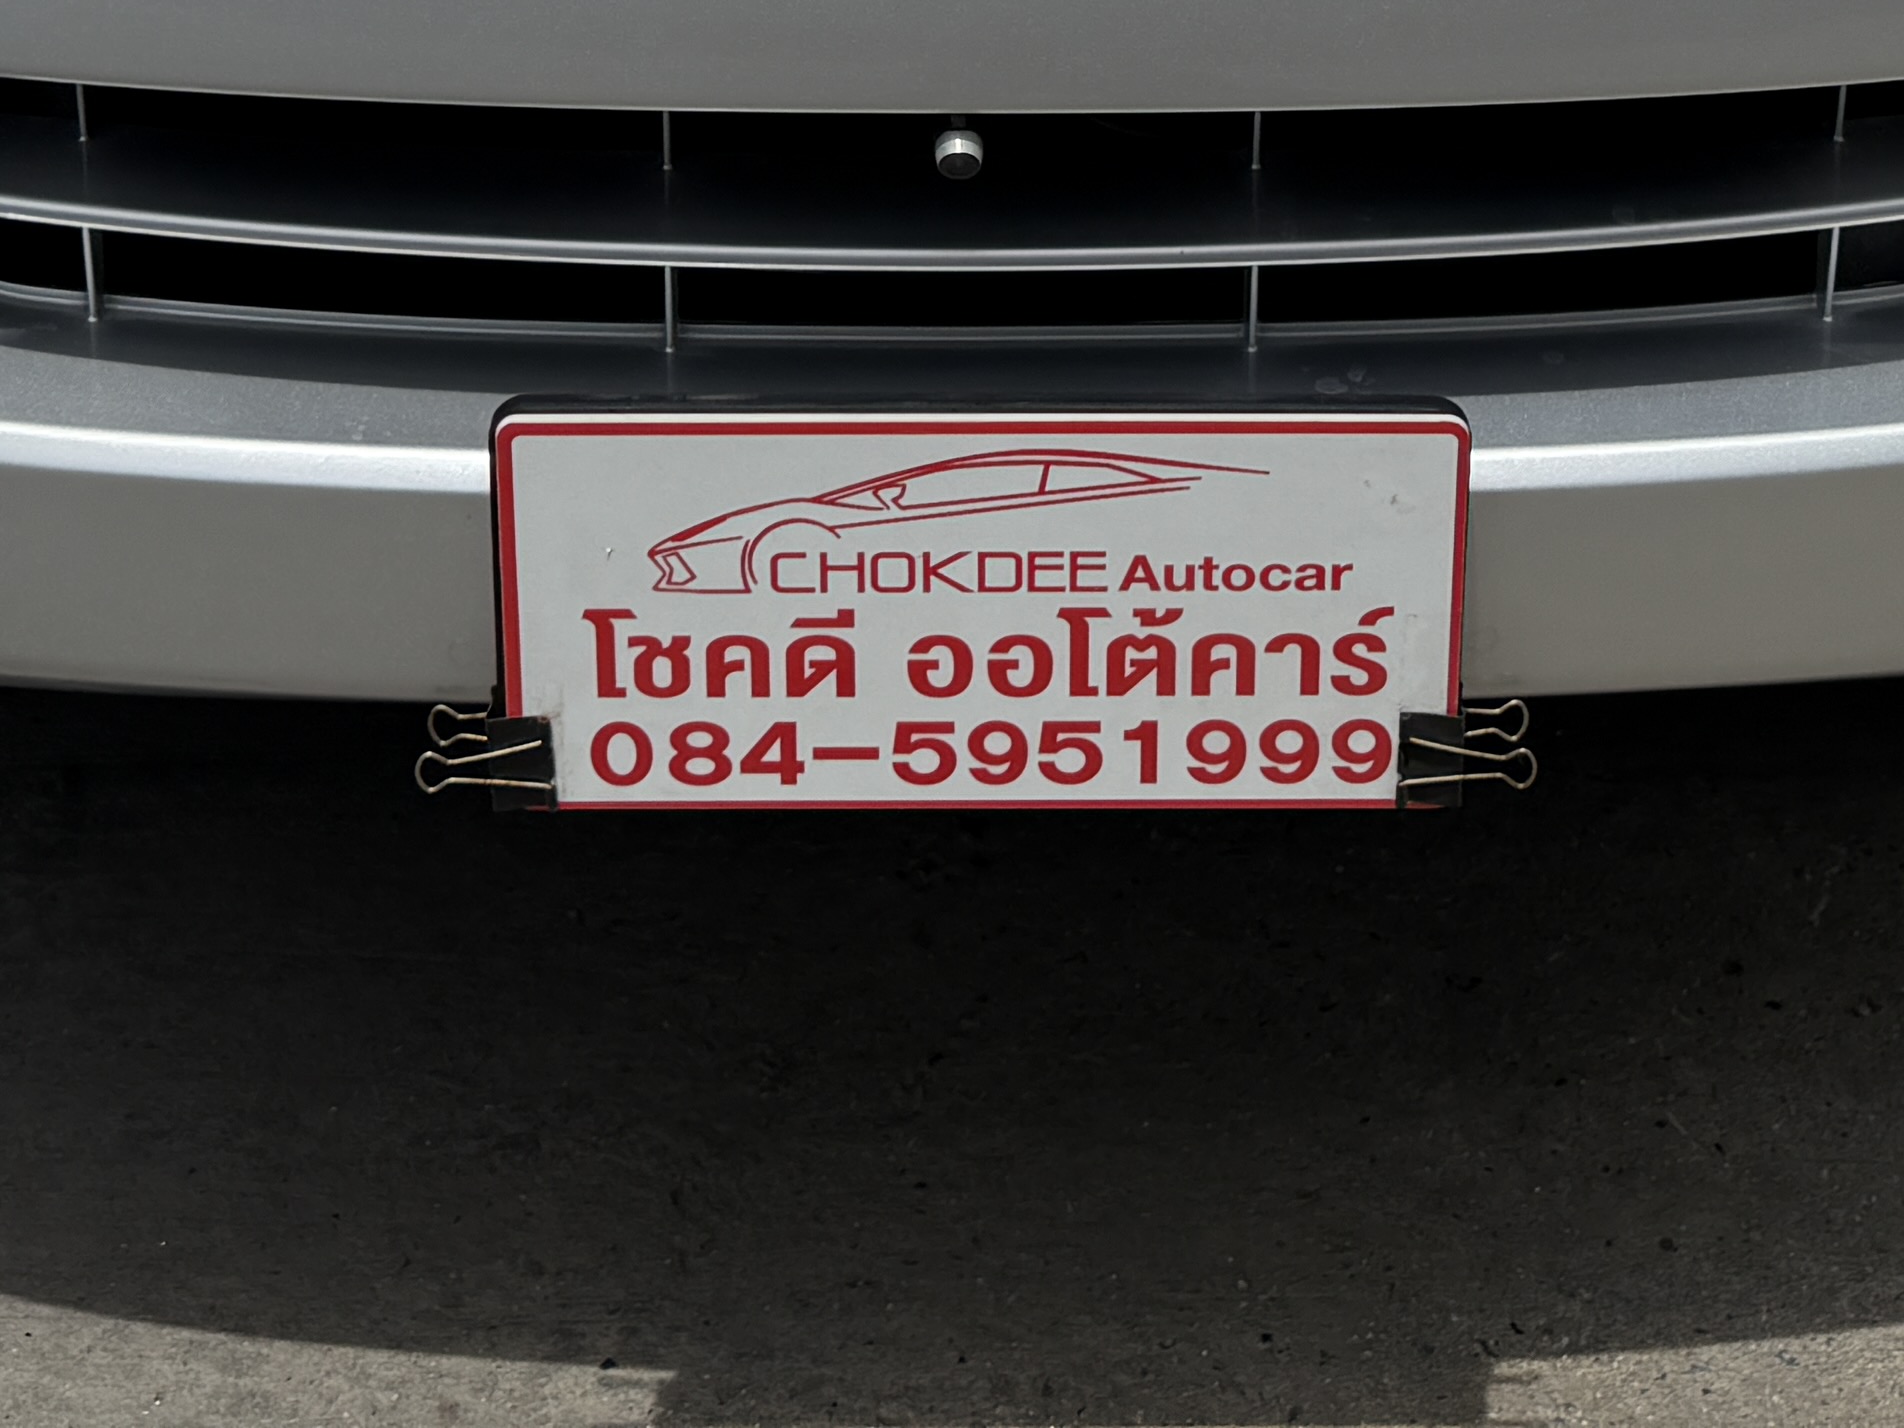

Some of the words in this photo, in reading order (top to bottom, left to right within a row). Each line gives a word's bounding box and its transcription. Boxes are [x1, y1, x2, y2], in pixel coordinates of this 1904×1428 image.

[769, 550, 1109, 594] CHOKDEE
[1117, 553, 1355, 593] Autocar
[581, 607, 857, 699] โชคดี
[906, 605, 1396, 698] ออโต้คาร์
[589, 717, 1393, 787] 084-5951999
